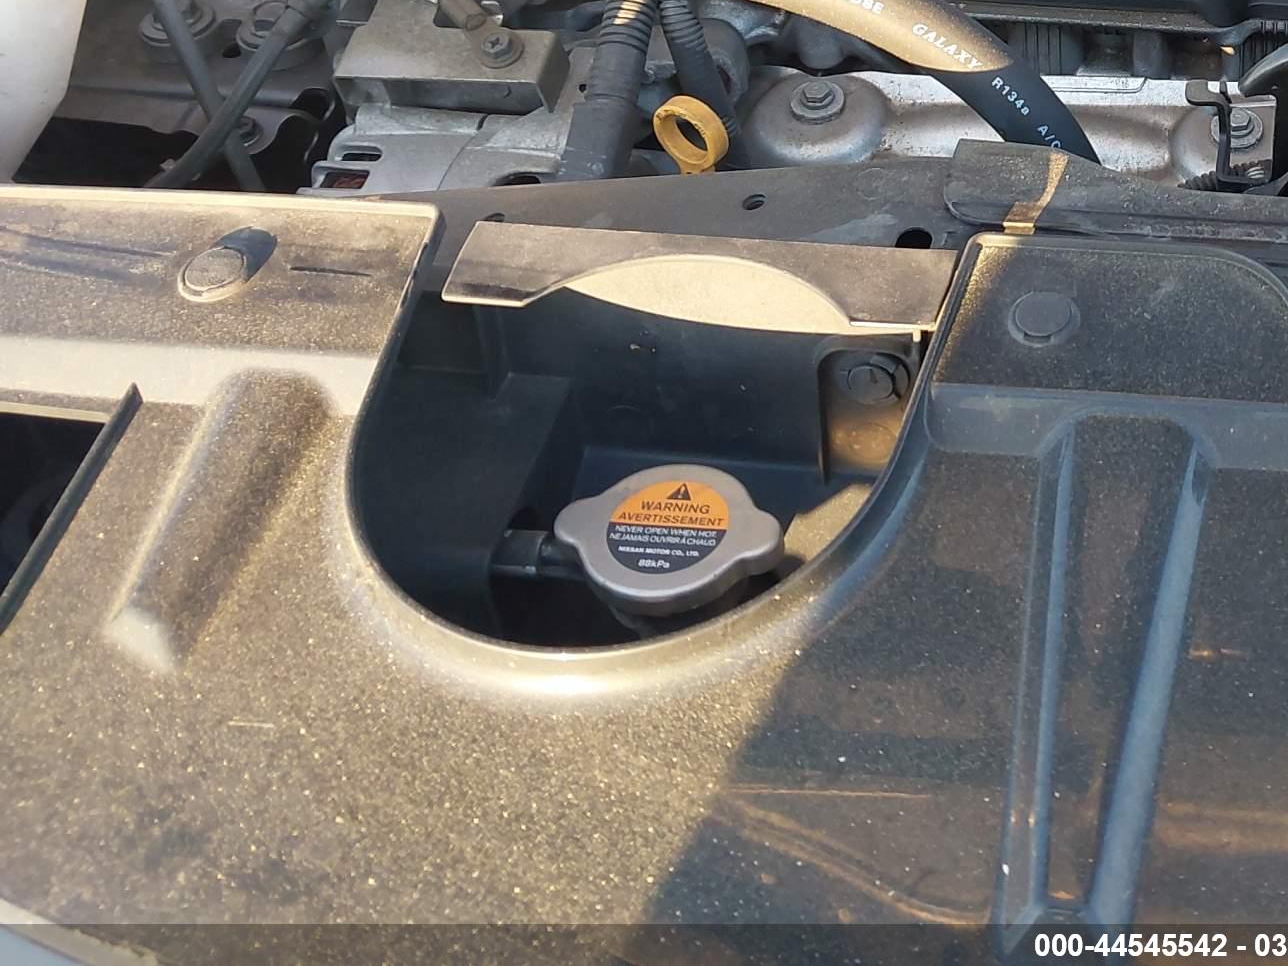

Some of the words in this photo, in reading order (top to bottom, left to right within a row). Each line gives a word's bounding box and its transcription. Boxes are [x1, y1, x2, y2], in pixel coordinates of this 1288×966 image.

[912, 22, 983, 70] GALAXY
[991, 76, 1030, 117] R134a
[641, 501, 711, 514] WARNING
[618, 512, 725, 526] AVERTISSEMENT
[615, 525, 644, 533] NEVER
[670, 528, 697, 536] WHEN
[609, 532, 621, 540] NE
[620, 533, 649, 542] JAMAIS
[650, 535, 680, 543] OUVRIR
[618, 545, 645, 553] NISSAN
[645, 547, 670, 555] MOTOR
